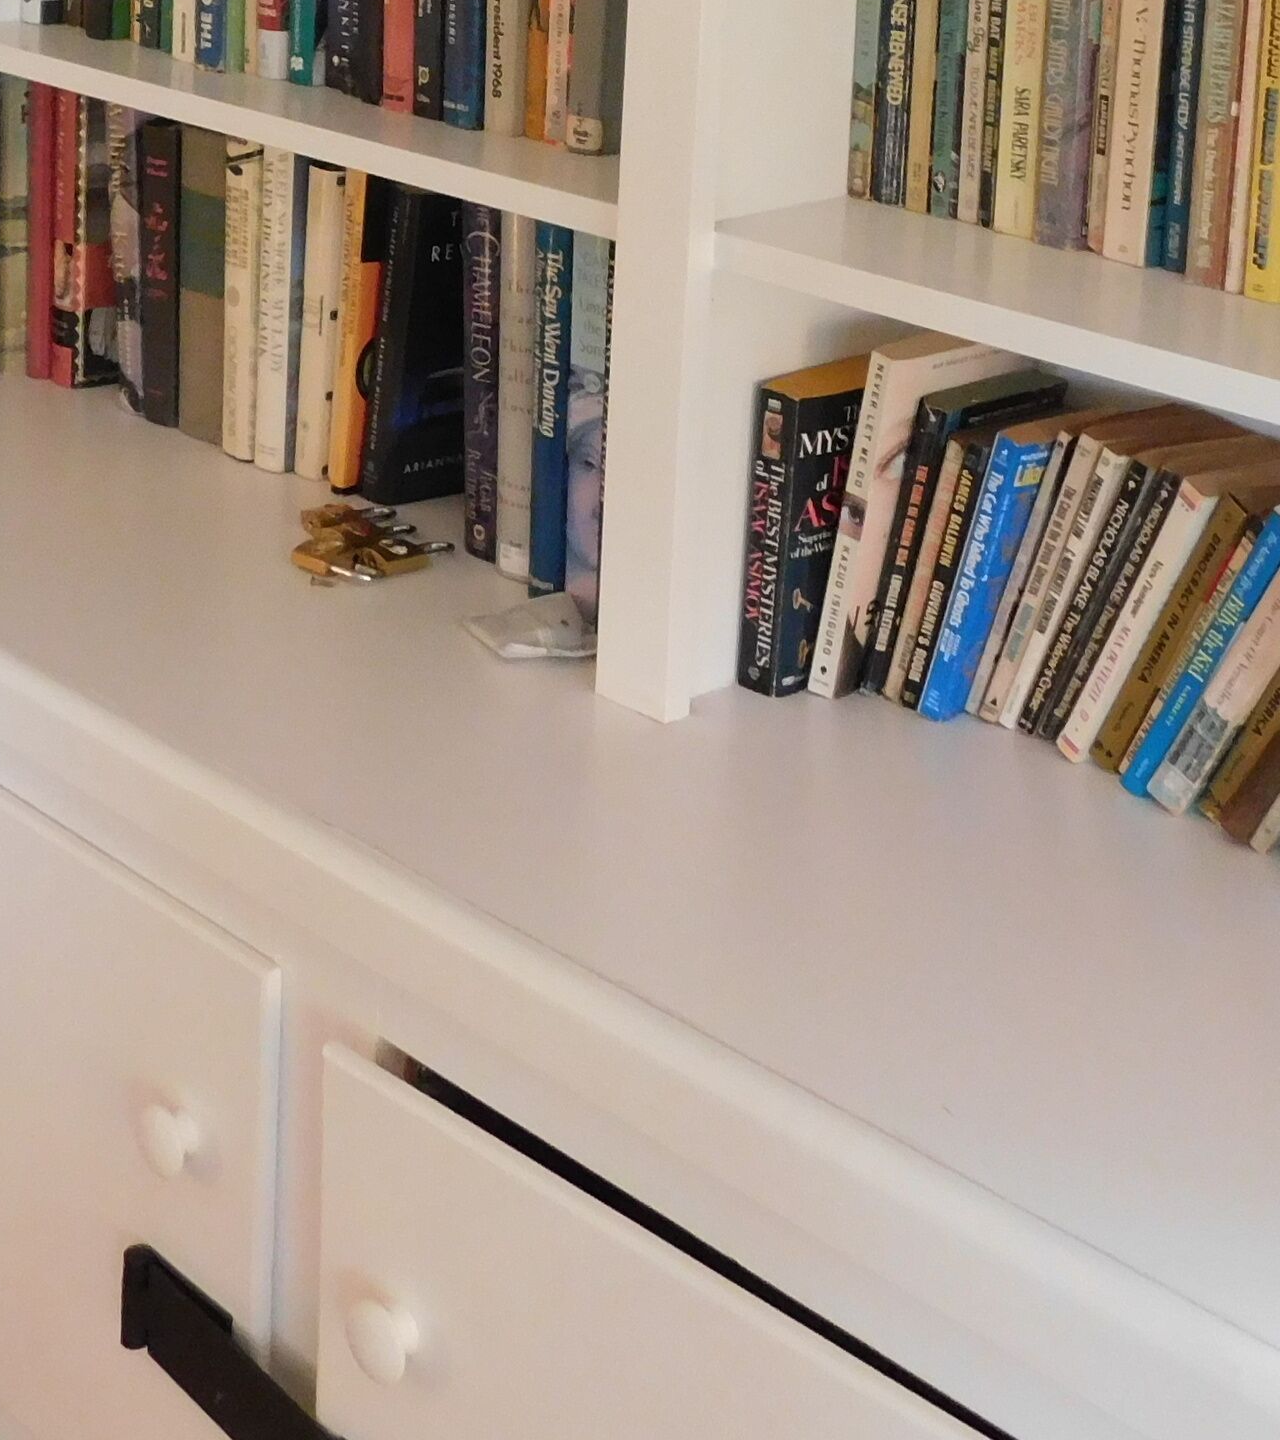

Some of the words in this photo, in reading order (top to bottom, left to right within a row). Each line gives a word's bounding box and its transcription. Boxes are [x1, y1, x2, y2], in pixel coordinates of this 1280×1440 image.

[200, 19, 214, 51] THE
[490, 62, 504, 100] 1968
[260, 214, 274, 292] HIGGINS
[546, 247, 565, 282] The
[465, 230, 501, 384] CHAMELEON
[544, 282, 563, 318] Spy
[541, 321, 562, 361] Went
[540, 364, 561, 439] Dancing
[868, 362, 885, 411] NEVER
[863, 414, 878, 444] LET
[753, 460, 766, 481] of
[858, 446, 871, 467] ME
[770, 460, 787, 497] The
[853, 469, 864, 490] GO
[956, 468, 974, 512] JAMES
[987, 470, 1006, 491] The
[749, 481, 769, 534] ISAAC
[983, 491, 999, 513] Cat
[768, 498, 786, 551] BEST
[938, 511, 962, 568] BALDWIN
[976, 512, 994, 538] Who
[836, 544, 852, 591] KAZUO
[965, 536, 987, 575] Talked
[1184, 532, 1221, 609] DEMOCRACY
[744, 548, 764, 622] ASIMOV
[962, 574, 975, 591] To
[755, 550, 780, 669] MYSTERIES
[822, 593, 843, 658] ISHIGURO
[918, 579, 945, 647] GIOVANNI'S
[948, 589, 971, 629] Ghosts
[1167, 606, 1185, 631] IN
[907, 647, 929, 683] ROOM
[1137, 631, 1171, 684] AMERICA
